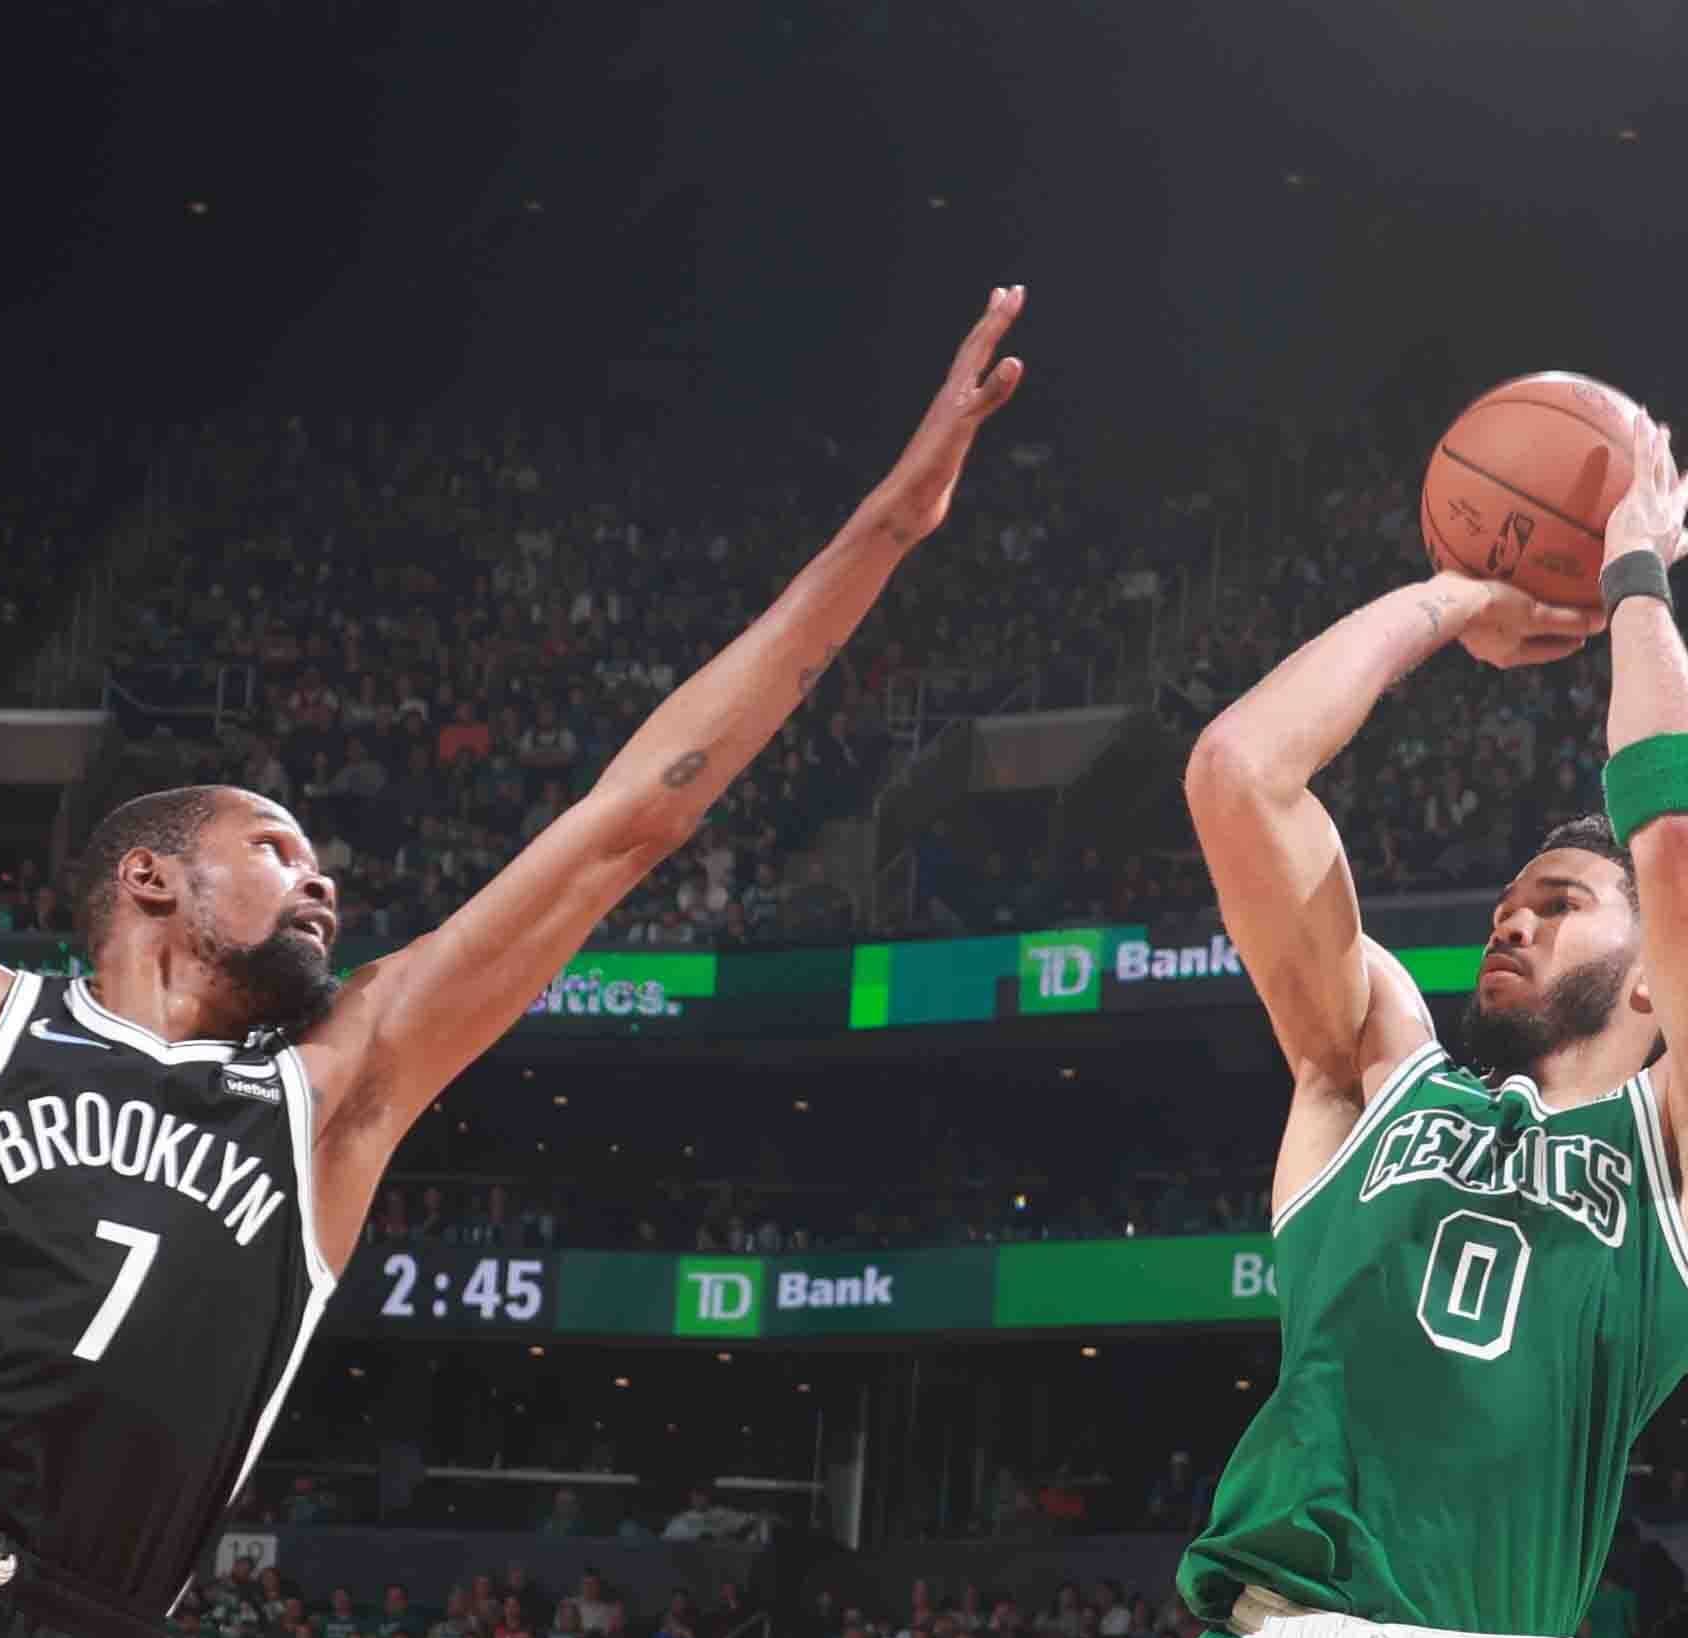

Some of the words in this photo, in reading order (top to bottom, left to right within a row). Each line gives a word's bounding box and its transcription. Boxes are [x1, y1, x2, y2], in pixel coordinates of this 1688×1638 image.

[1028, 943, 1095, 997] TD
[1115, 934, 1243, 981] Bank
[1360, 1108, 1633, 1249] CELTICS
[72, 1218, 162, 1362] 7
[382, 1253, 544, 1320] 2:45
[687, 1271, 754, 1320] TD
[777, 1264, 893, 1309] Bank
[1416, 1208, 1532, 1361] 0
